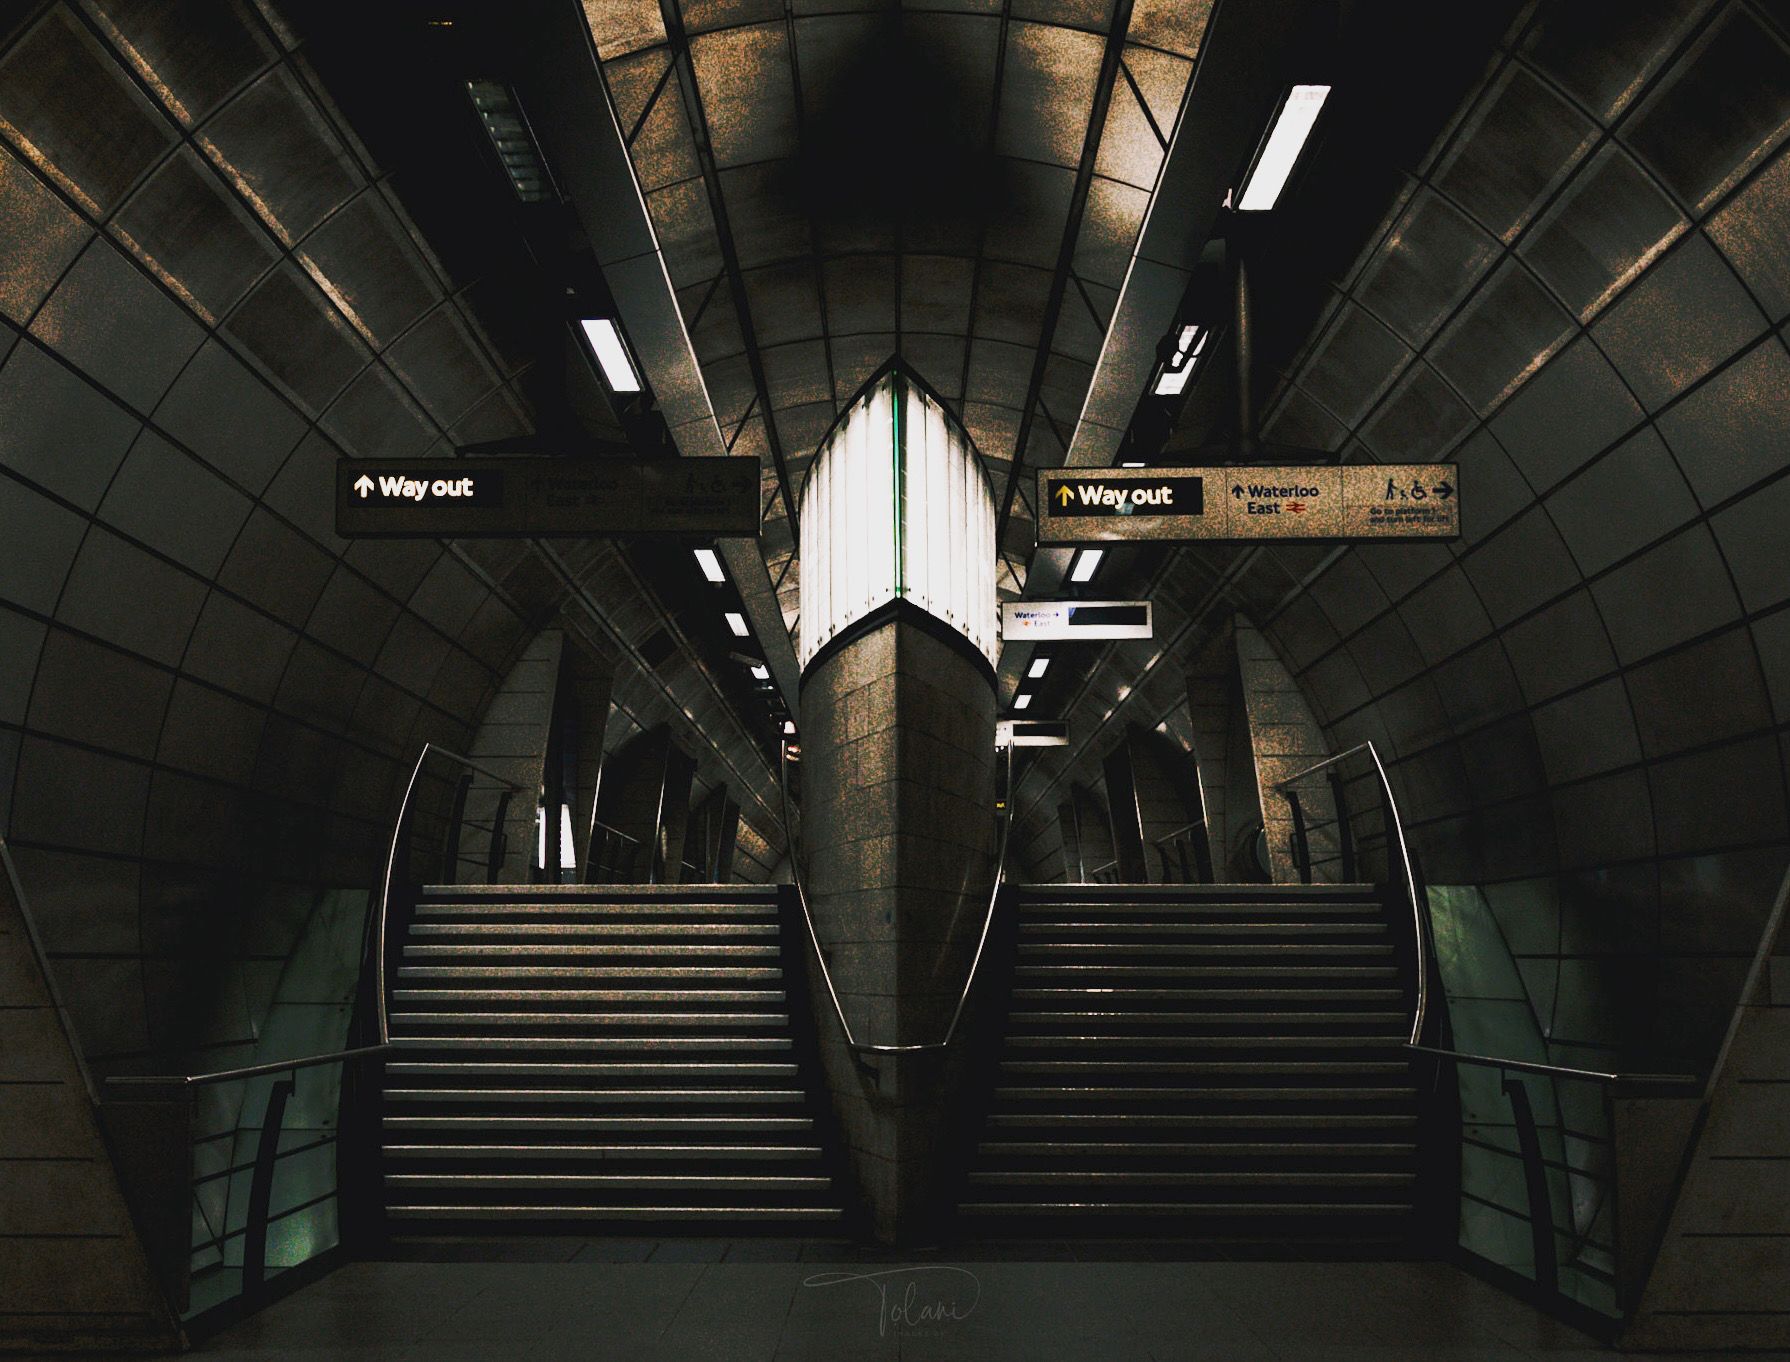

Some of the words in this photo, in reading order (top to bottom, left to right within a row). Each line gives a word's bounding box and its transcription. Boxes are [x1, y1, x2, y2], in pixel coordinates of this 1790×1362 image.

[379, 475, 429, 502] Way
[434, 475, 474, 497] out
[1078, 485, 1127, 509] Way
[1131, 486, 1173, 505] out
[1248, 485, 1319, 498] Waterloo
[1247, 502, 1281, 515] East
